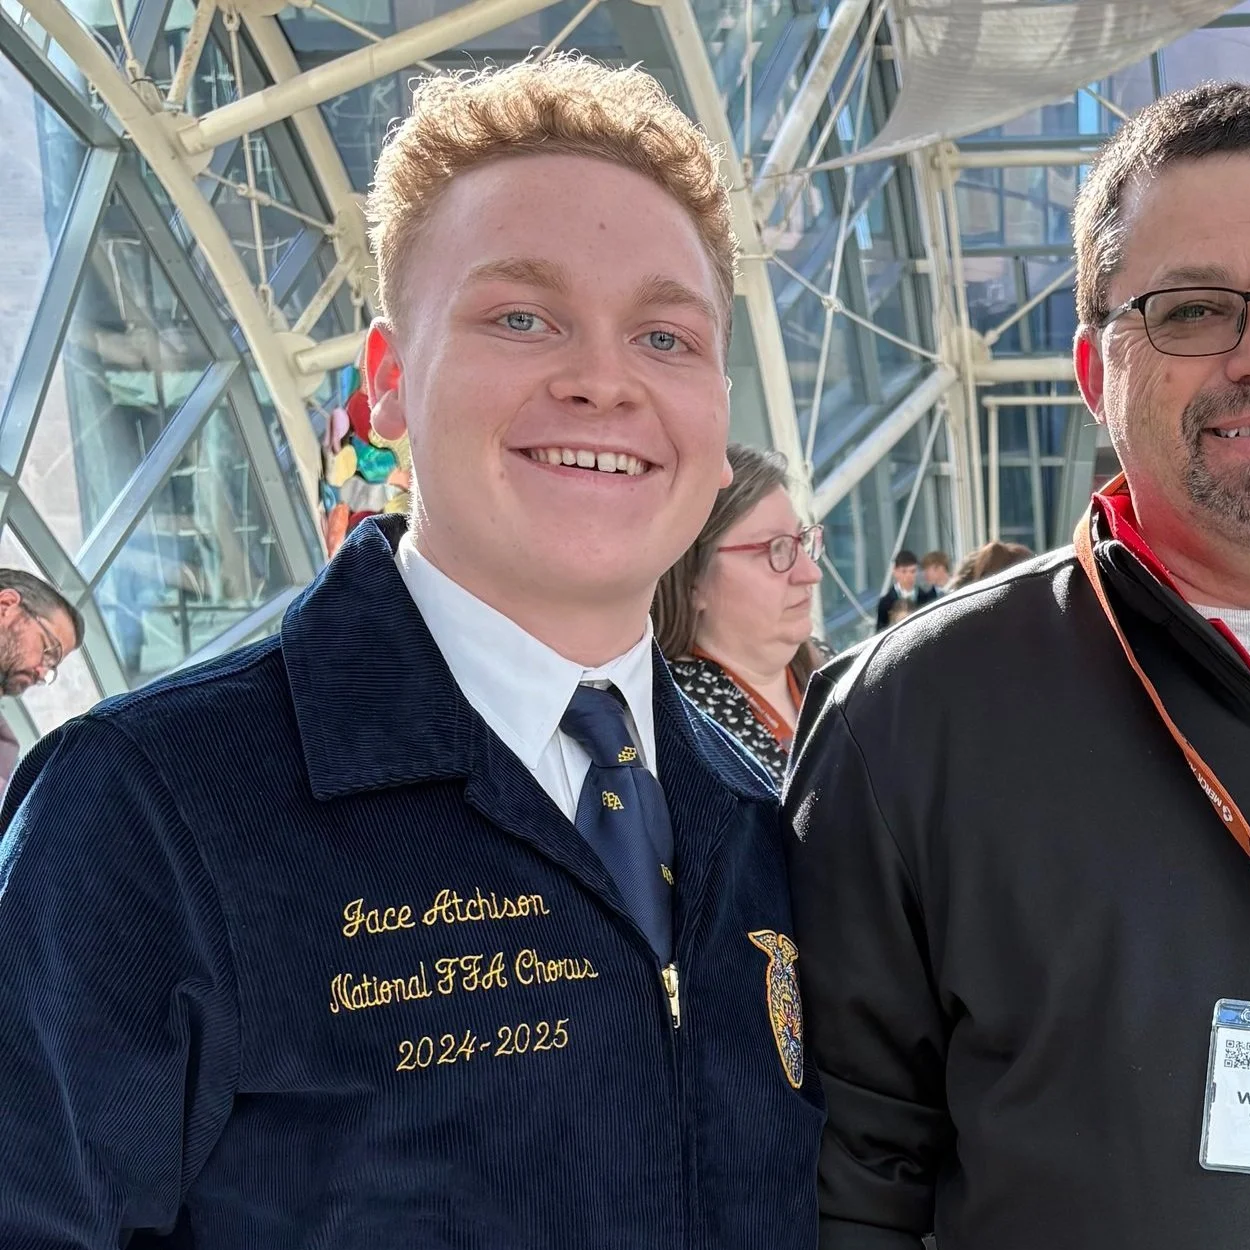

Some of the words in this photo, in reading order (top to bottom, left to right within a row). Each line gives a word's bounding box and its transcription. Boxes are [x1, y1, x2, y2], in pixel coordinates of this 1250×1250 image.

[602, 790, 624, 811] FFA
[342, 898, 415, 937] Jace
[422, 888, 550, 926] Atchison
[329, 961, 432, 1014] National
[434, 952, 508, 995] FFA
[514, 949, 599, 985] Chorus
[396, 1018, 570, 1072] 2024-2025
